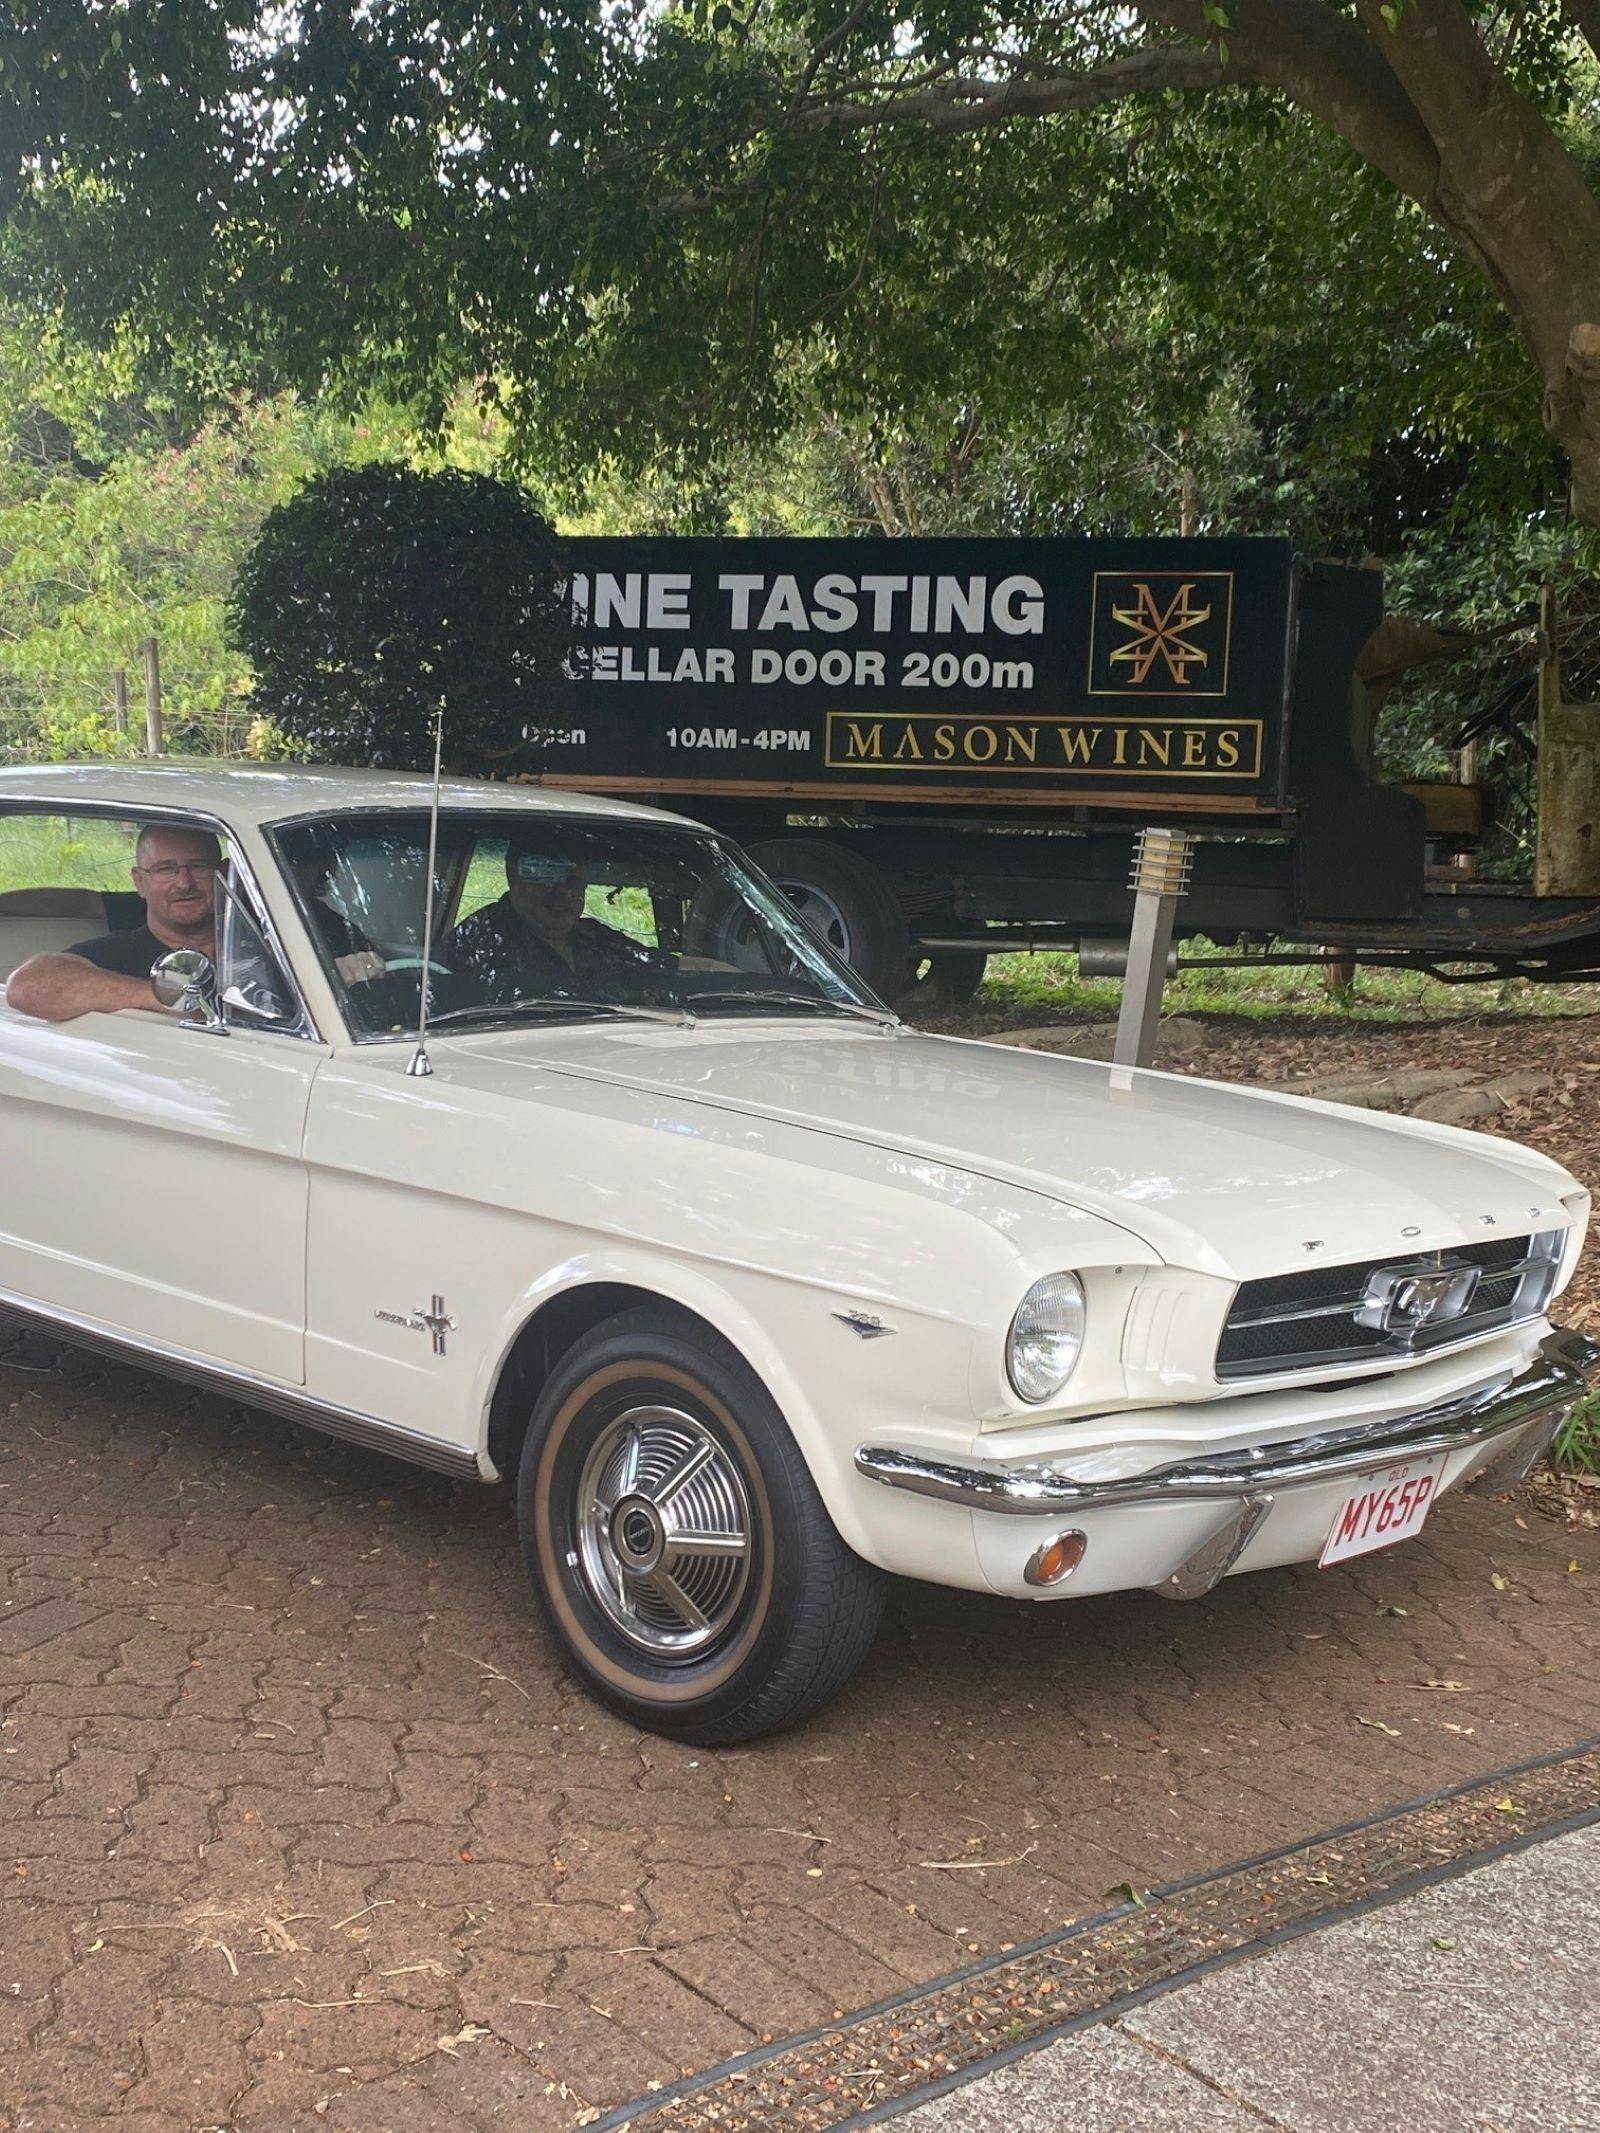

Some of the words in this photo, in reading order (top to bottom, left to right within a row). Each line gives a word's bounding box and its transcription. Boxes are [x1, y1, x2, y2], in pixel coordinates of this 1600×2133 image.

[509, 572, 692, 629] INE
[718, 573, 1045, 635] TASTING
[751, 649, 886, 686] DOOR
[900, 652, 1034, 689] 200m
[846, 722, 1040, 764] MASON
[1058, 727, 1240, 768] WINES
[1334, 1475, 1433, 1547] MY65P
